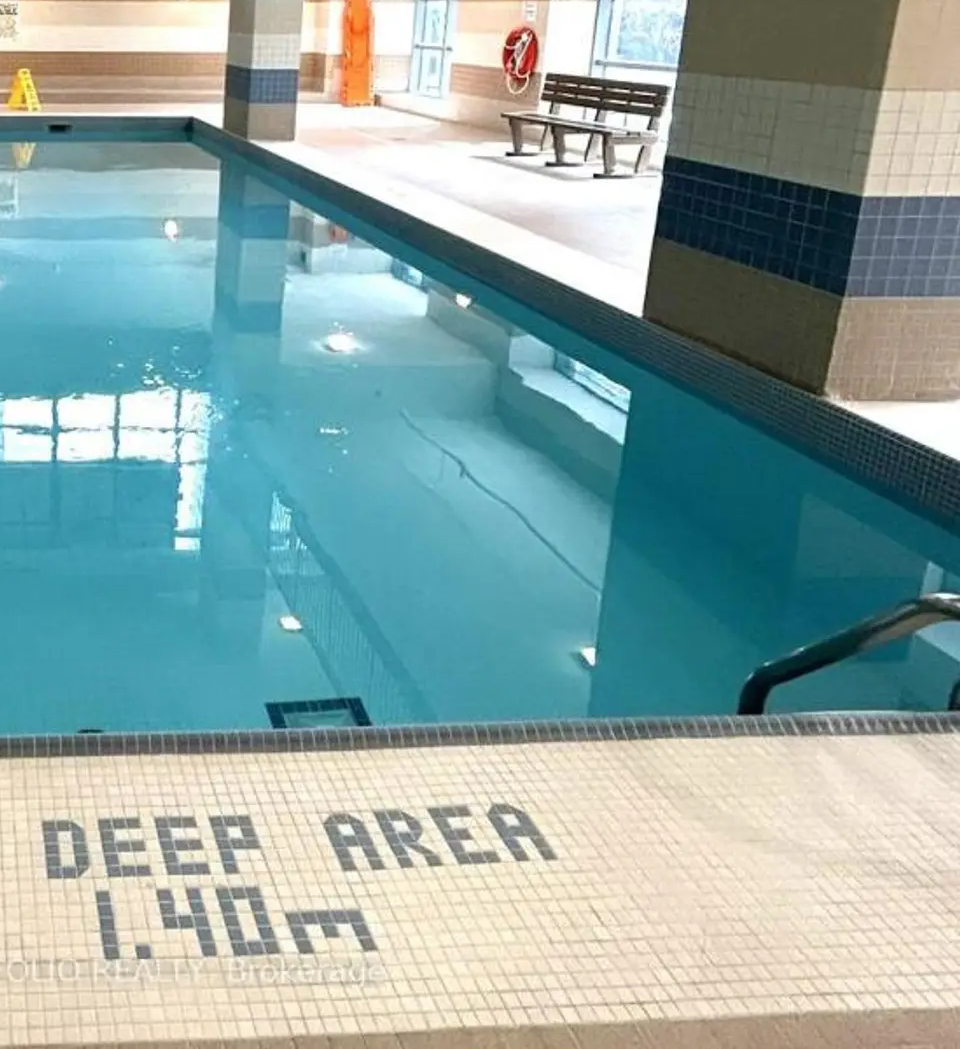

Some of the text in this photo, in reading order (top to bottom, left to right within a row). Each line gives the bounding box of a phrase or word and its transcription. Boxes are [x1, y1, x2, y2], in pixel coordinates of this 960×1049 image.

[42, 802, 558, 880] DEEP AREA
[96, 886, 379, 961] 1.40m
